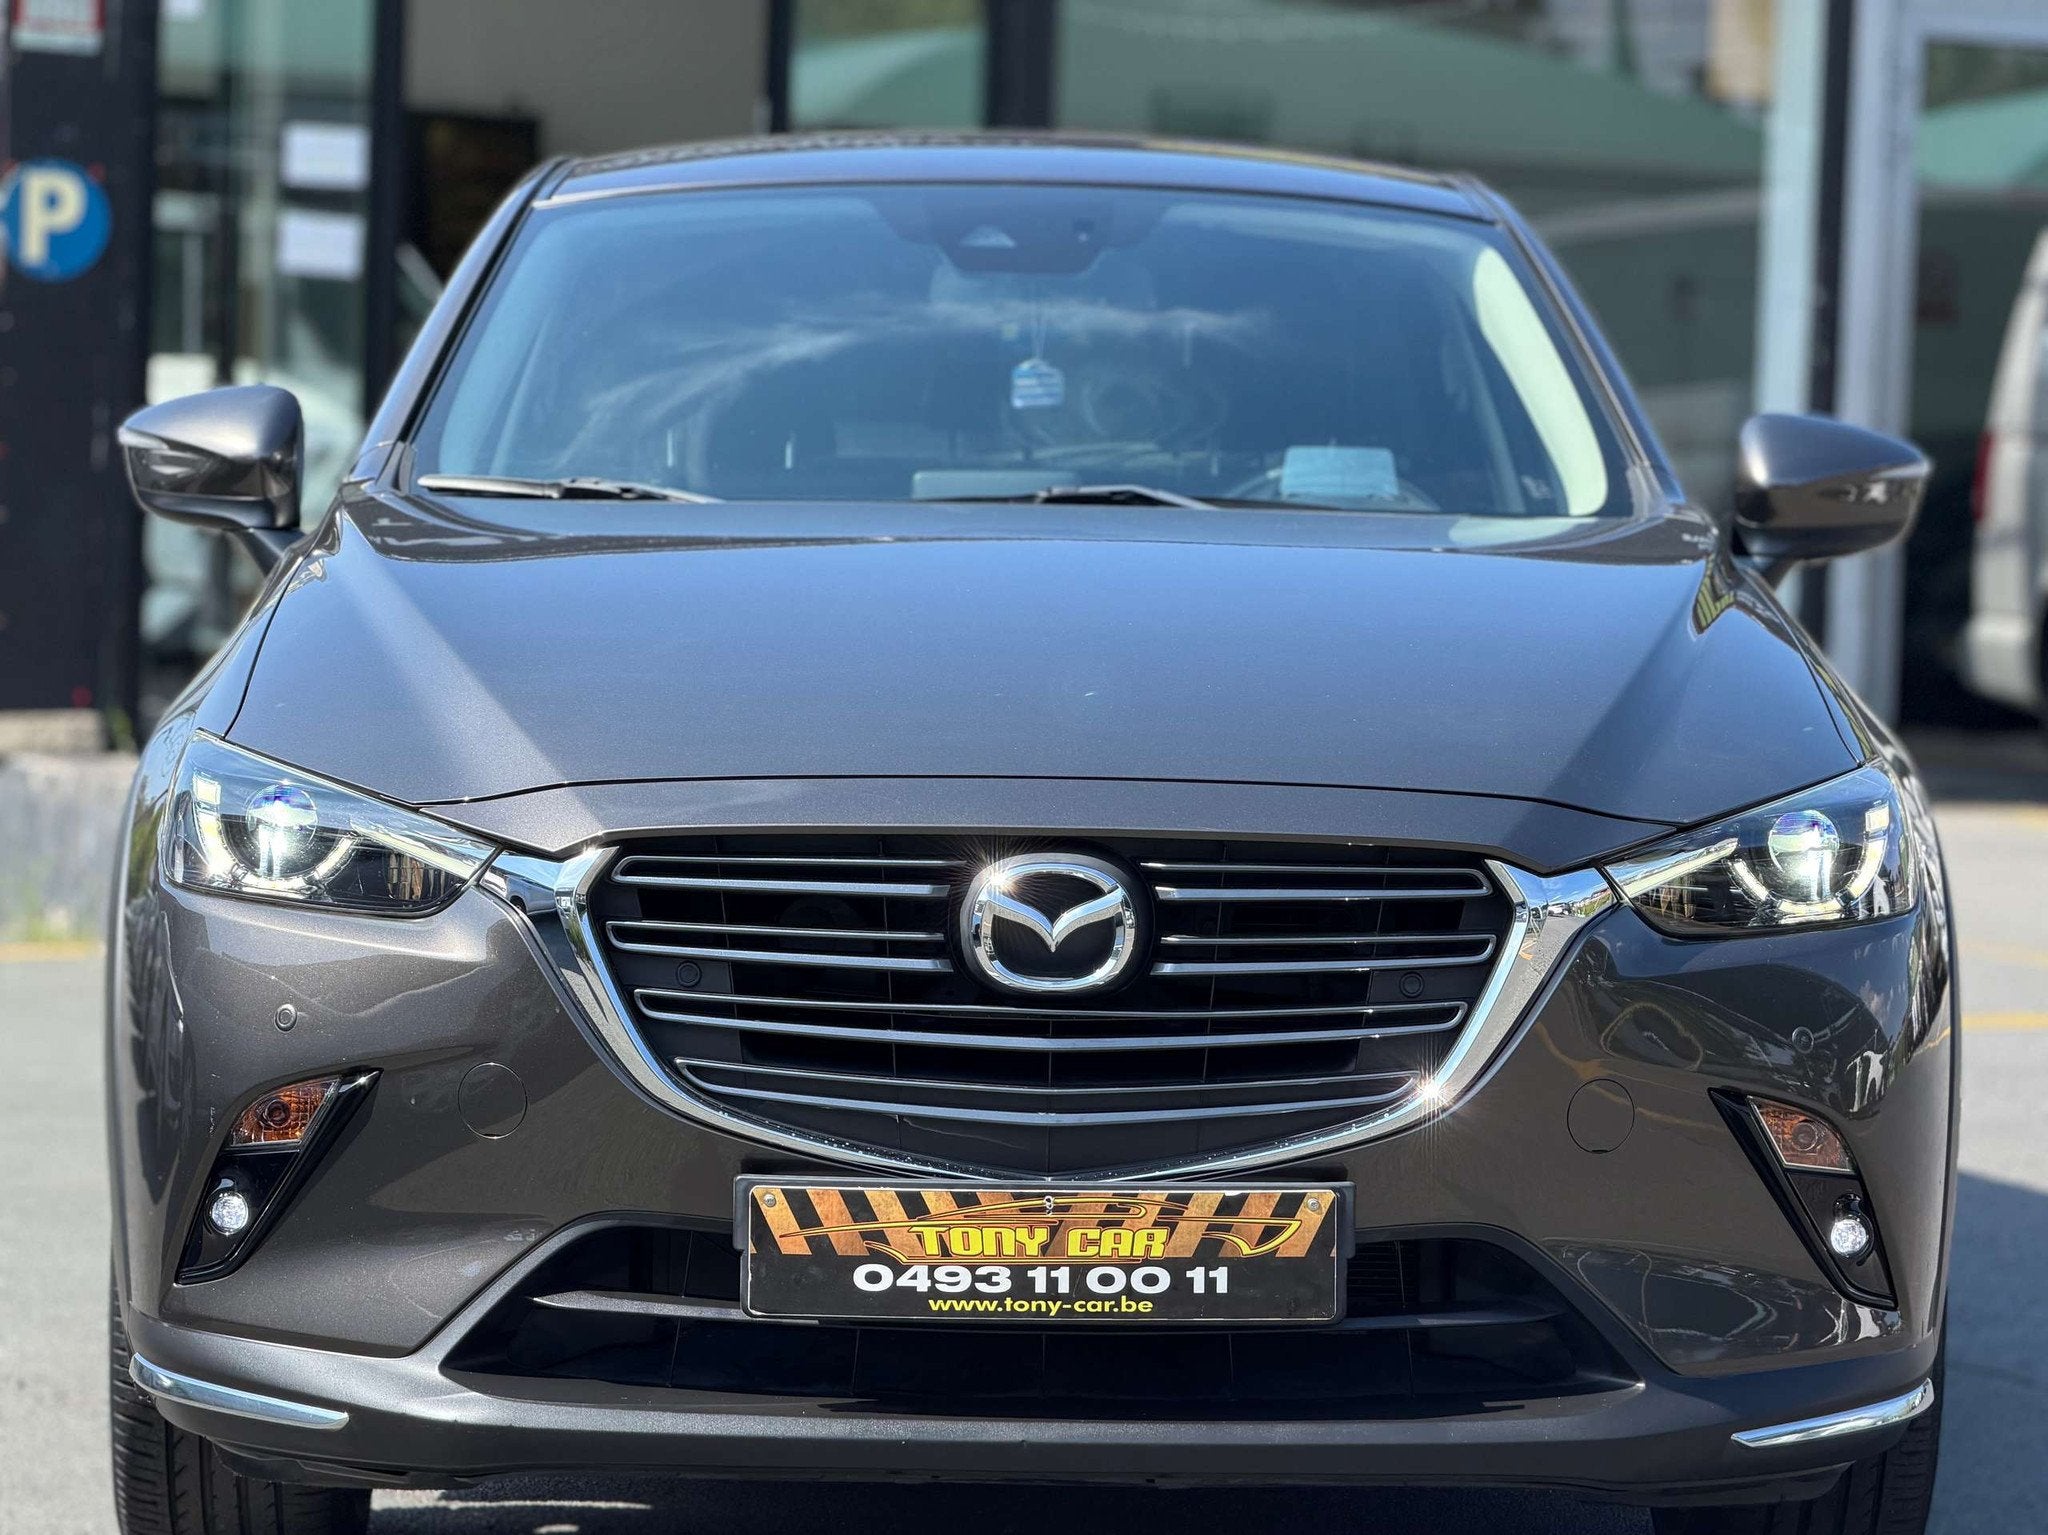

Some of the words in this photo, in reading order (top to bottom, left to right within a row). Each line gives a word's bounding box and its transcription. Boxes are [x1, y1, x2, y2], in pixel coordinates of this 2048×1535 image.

[20, 168, 87, 265] P
[908, 1224, 1050, 1258] TONY
[1069, 1225, 1169, 1258] CAR
[852, 1264, 1013, 1294] 0493
[1027, 1265, 1072, 1294] 11
[1085, 1265, 1171, 1294] 00
[1186, 1266, 1229, 1294] 11
[928, 1297, 1154, 1316] www.tony-car.be
